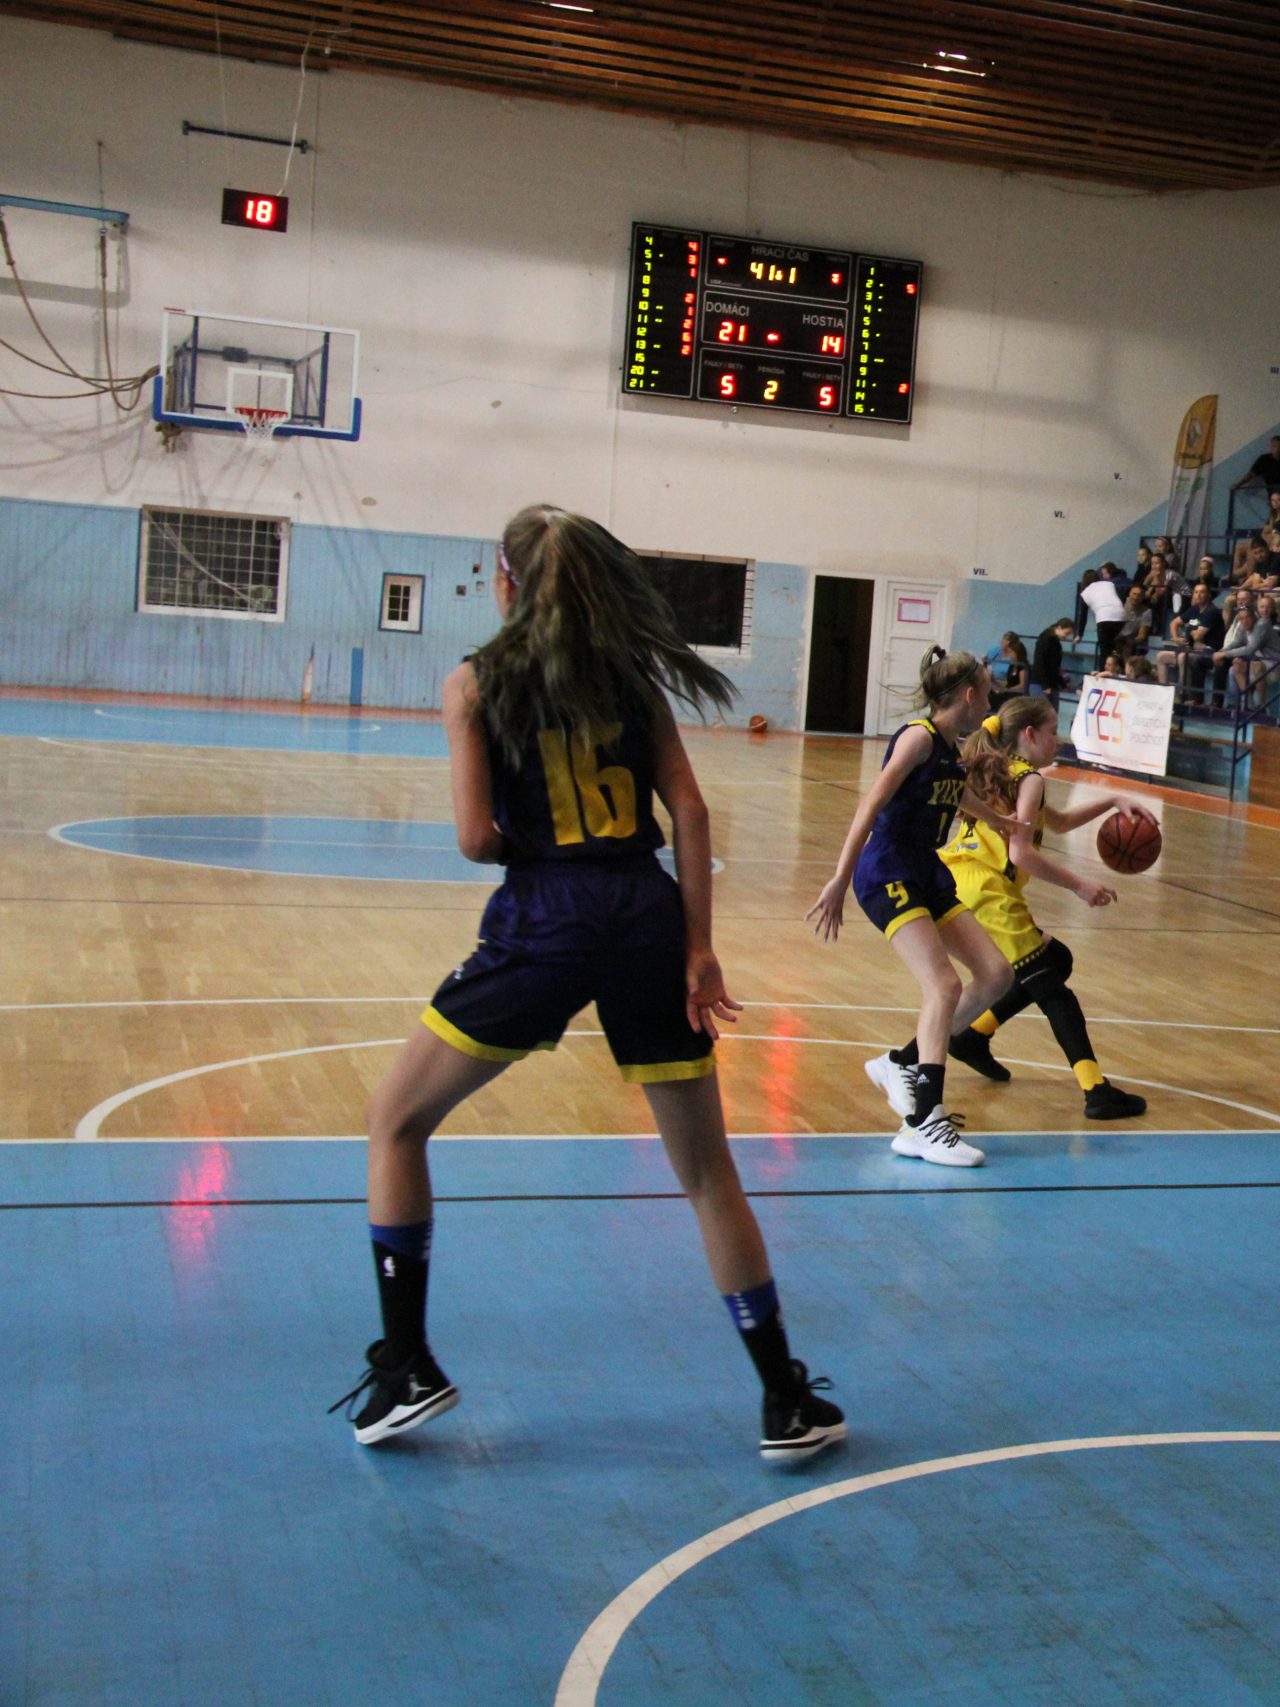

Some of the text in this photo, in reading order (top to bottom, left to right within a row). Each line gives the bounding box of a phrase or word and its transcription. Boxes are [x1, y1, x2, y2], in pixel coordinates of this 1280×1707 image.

[246, 199, 273, 223] 18
[645, 236, 699, 252] 4 4
[644, 249, 652, 258] 5
[645, 262, 697, 278] 7 1
[870, 267, 875, 275] 1
[642, 275, 651, 284] 8
[866, 279, 917, 295] 2 5
[641, 288, 650, 297] 9
[865, 292, 873, 301] 3
[638, 301, 695, 316] 10 1
[705, 301, 750, 316] DOMÁCI
[864, 304, 872, 313] 4
[637, 314, 648, 323] 11
[802, 314, 844, 329] HOSTIA
[863, 317, 871, 326] 5
[717, 320, 842, 354] 21 14
[862, 329, 870, 338] 6
[862, 342, 869, 350] 7
[630, 365, 644, 375] 20
[859, 366, 867, 376] 9
[629, 378, 644, 388] 21
[856, 379, 866, 388] 11
[720, 374, 833, 407] 5 2 5
[1053, 510, 1065, 519] VI.
[973, 567, 988, 576] VII.
[537, 720, 638, 846] 16
